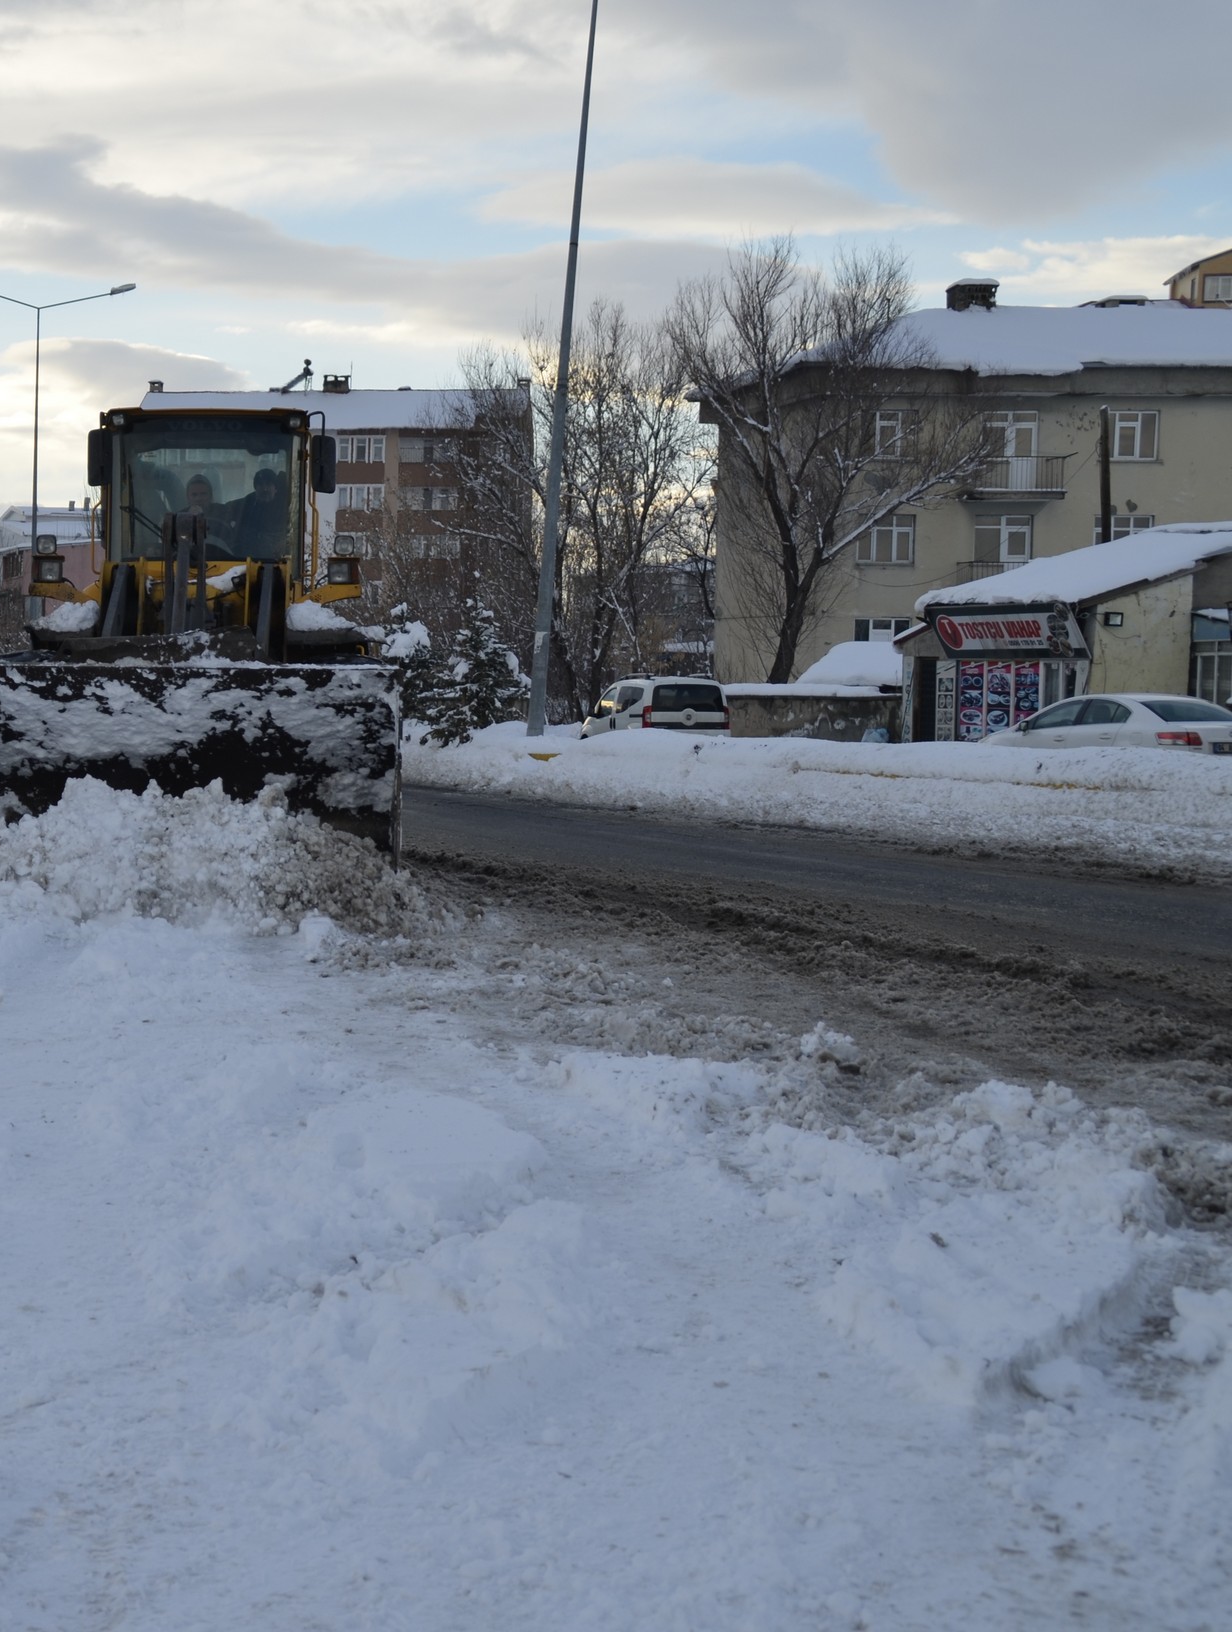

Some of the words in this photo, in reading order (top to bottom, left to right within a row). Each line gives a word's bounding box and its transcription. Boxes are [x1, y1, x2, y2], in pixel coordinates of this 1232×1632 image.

[169, 420, 242, 430] VOLVO
[958, 622, 1004, 641] TOSTÇU
[1003, 620, 1042, 638] VAHAP
